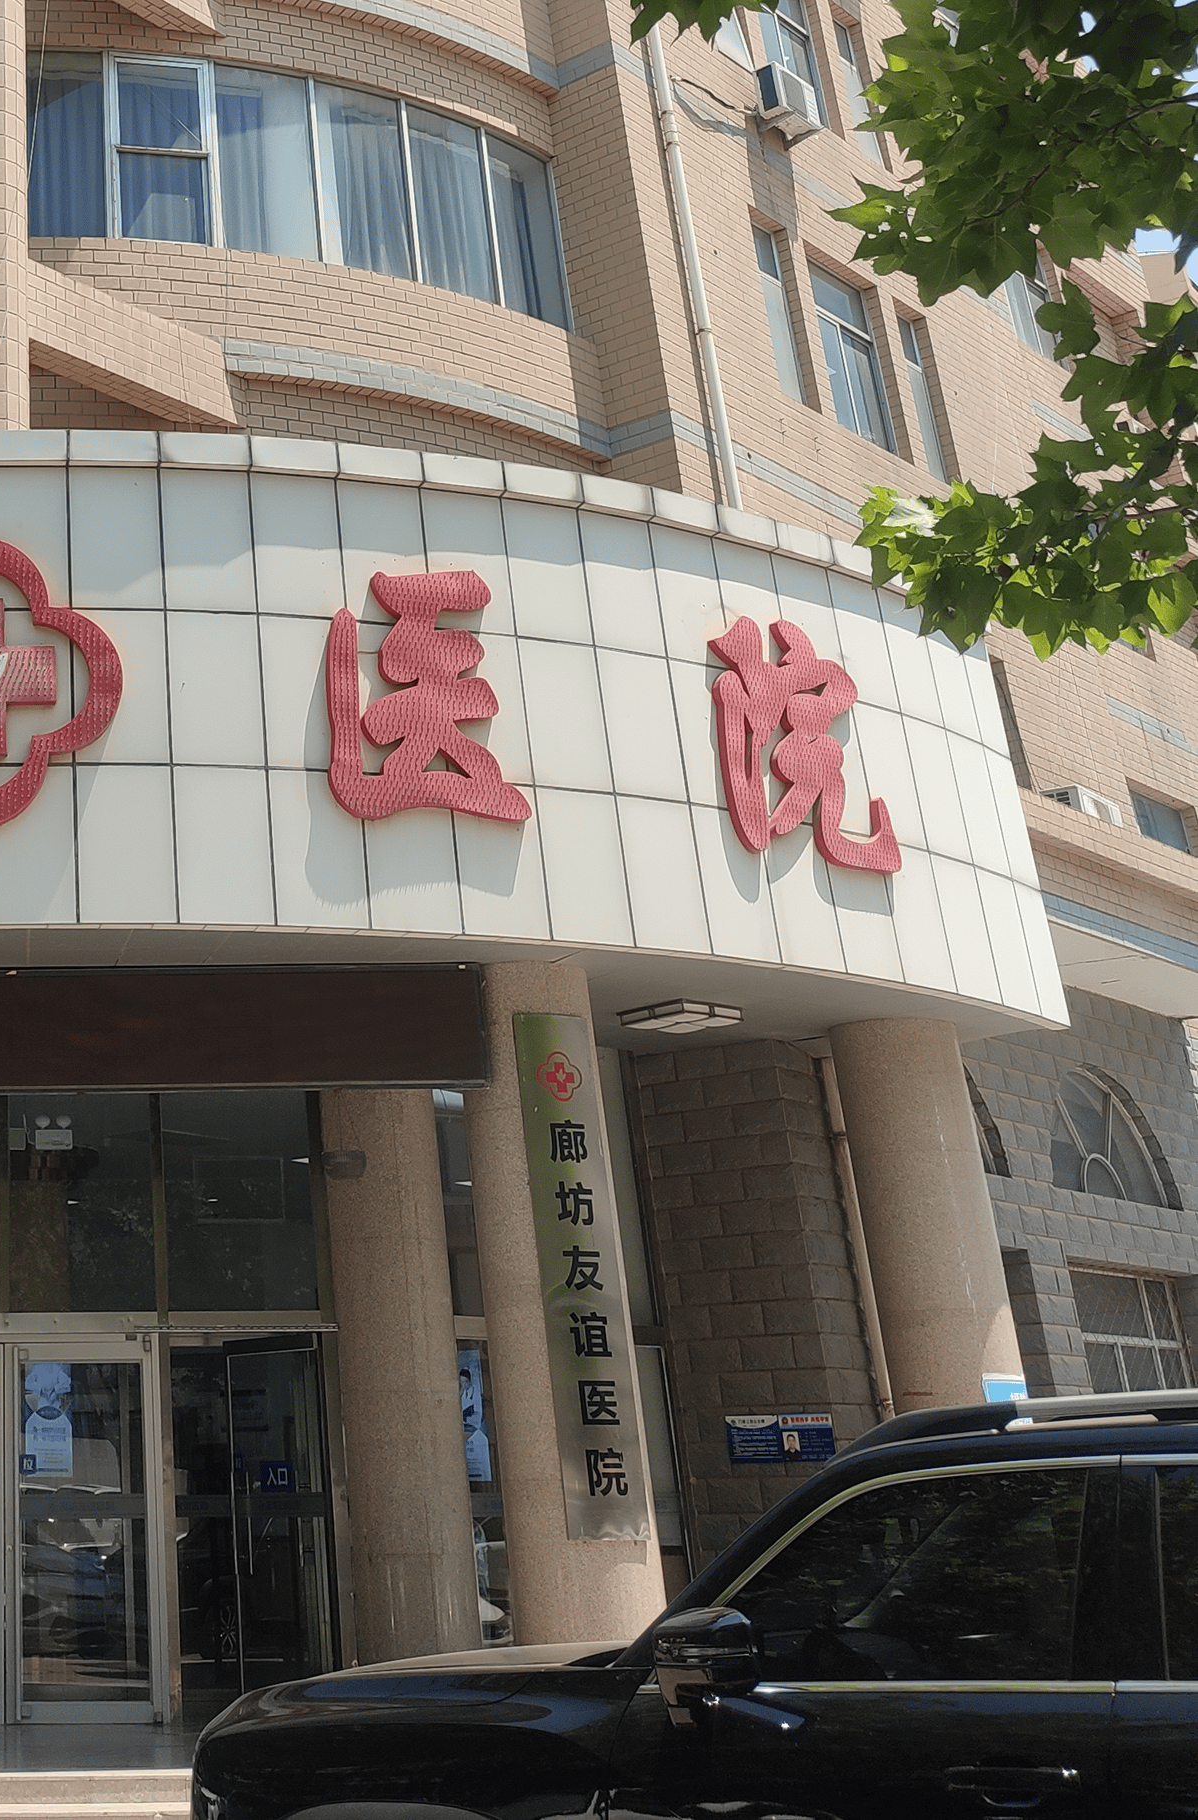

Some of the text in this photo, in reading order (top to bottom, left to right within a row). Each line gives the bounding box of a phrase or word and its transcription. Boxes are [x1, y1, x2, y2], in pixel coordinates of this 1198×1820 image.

[326, 569, 902, 874] 医院
[549, 1118, 629, 1497] 廊坊友谊医院
[23, 1457, 34, 1471] 拉
[266, 1466, 288, 1486] 入口
